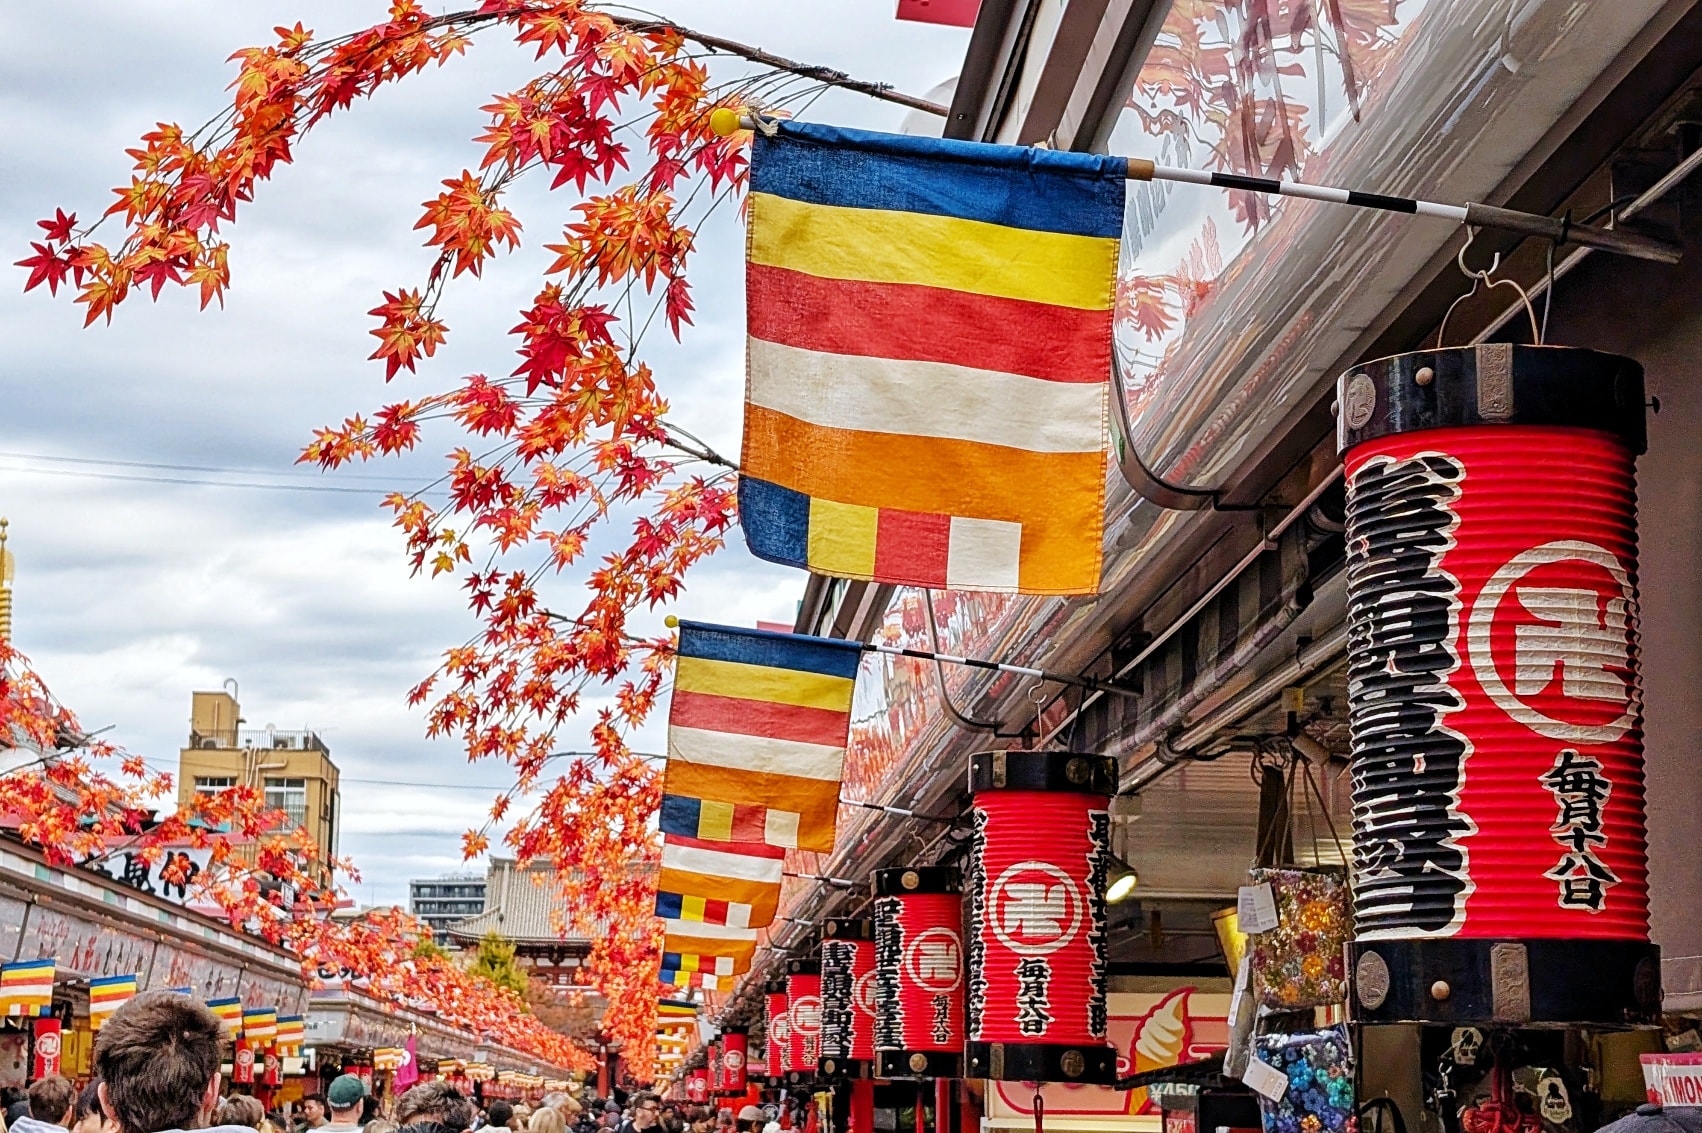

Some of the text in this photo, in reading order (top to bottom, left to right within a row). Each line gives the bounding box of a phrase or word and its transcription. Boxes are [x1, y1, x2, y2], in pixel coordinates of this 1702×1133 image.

[1541, 750, 1619, 912] 毎月十八日
[931, 995, 953, 1044] 毎月十八日
[1015, 958, 1053, 1035] 毎月十八日
